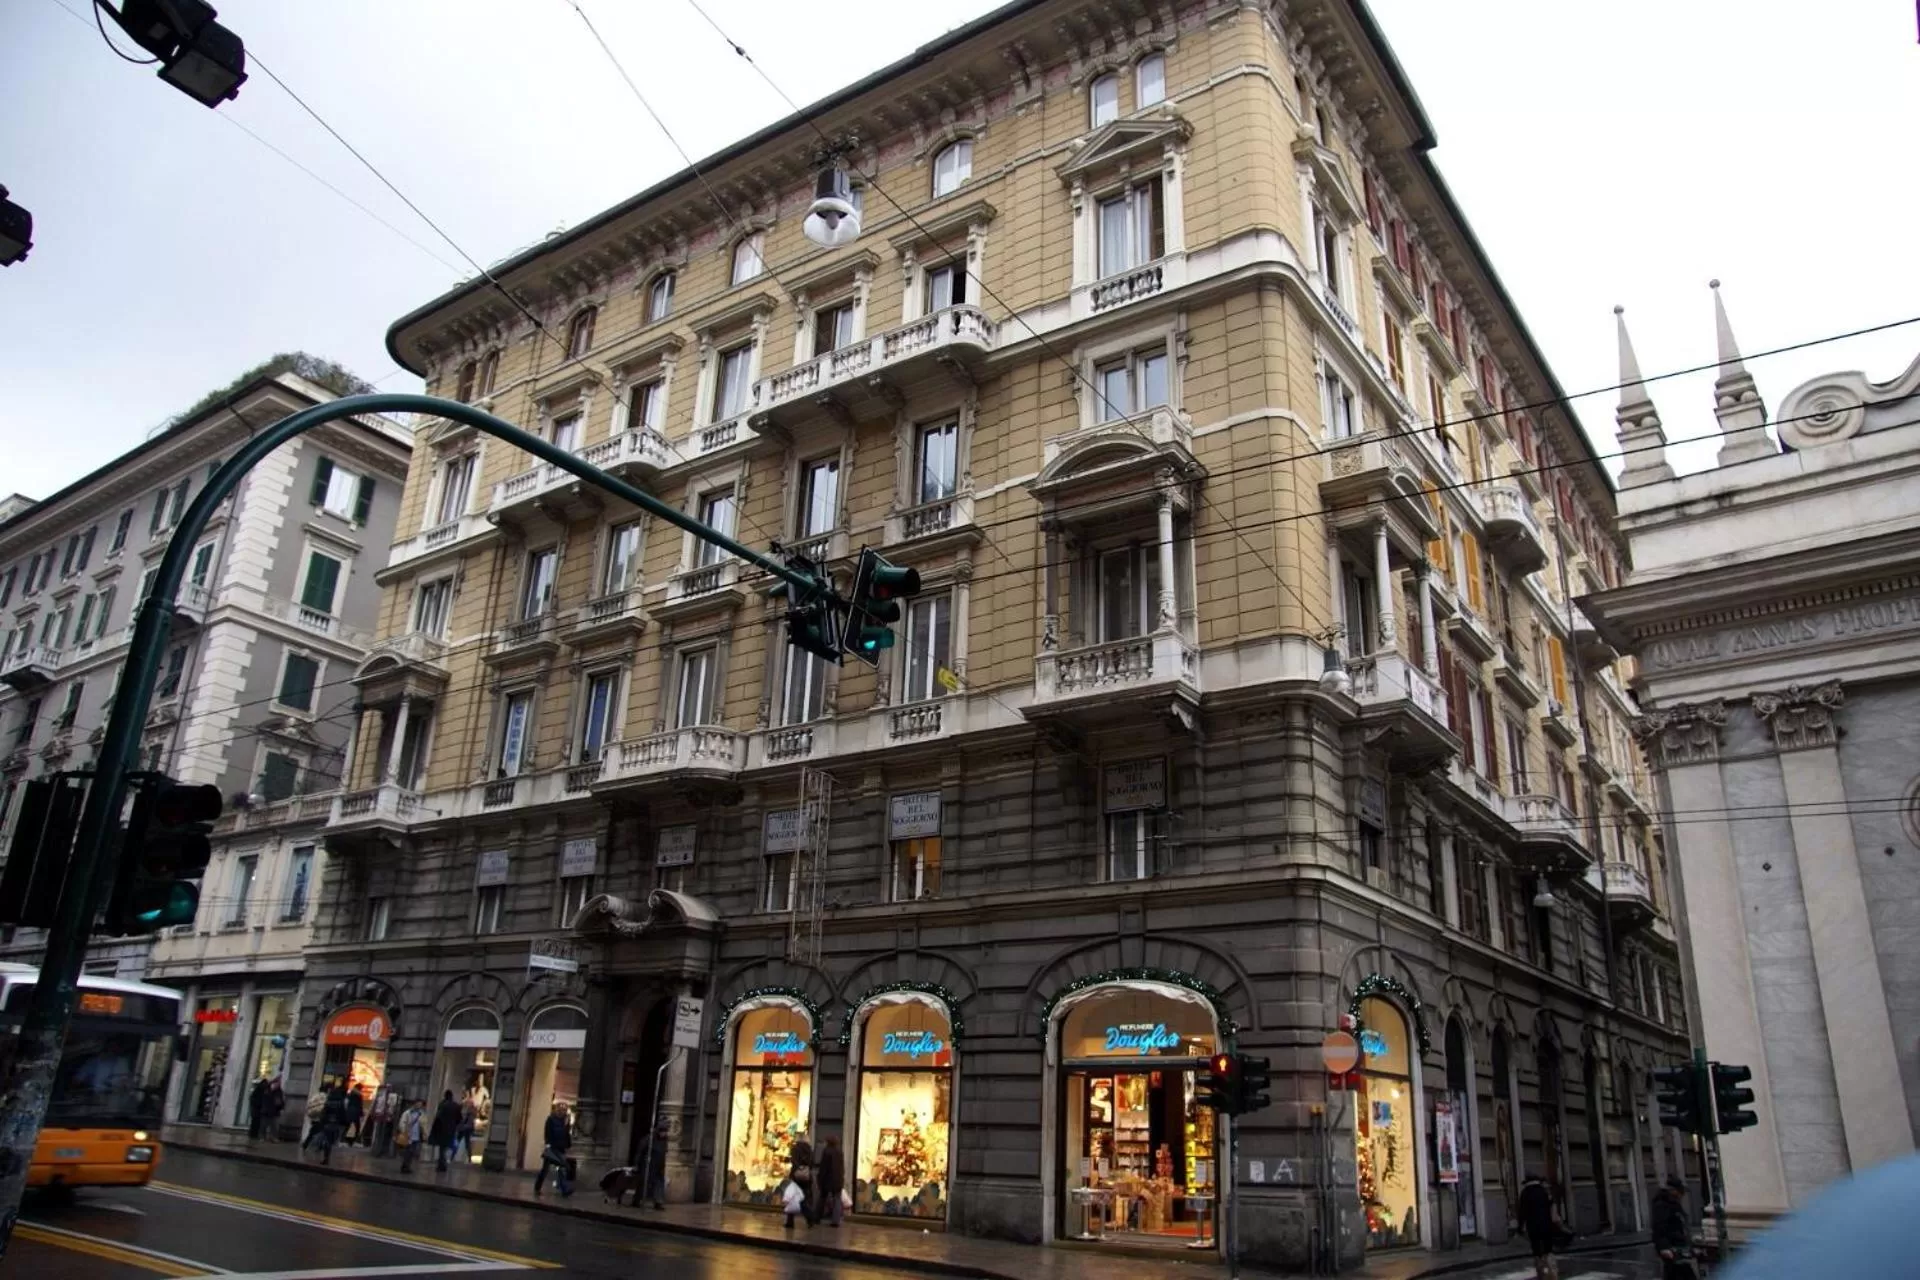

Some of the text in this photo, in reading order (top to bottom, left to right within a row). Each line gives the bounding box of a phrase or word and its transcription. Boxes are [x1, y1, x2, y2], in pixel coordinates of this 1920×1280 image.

[1732, 618, 1817, 654] ANNIS
[332, 1024, 368, 1037] expert
[754, 1032, 808, 1056] Douglas
[1105, 1023, 1180, 1056] Douglas
[882, 1031, 944, 1059] Douglas
